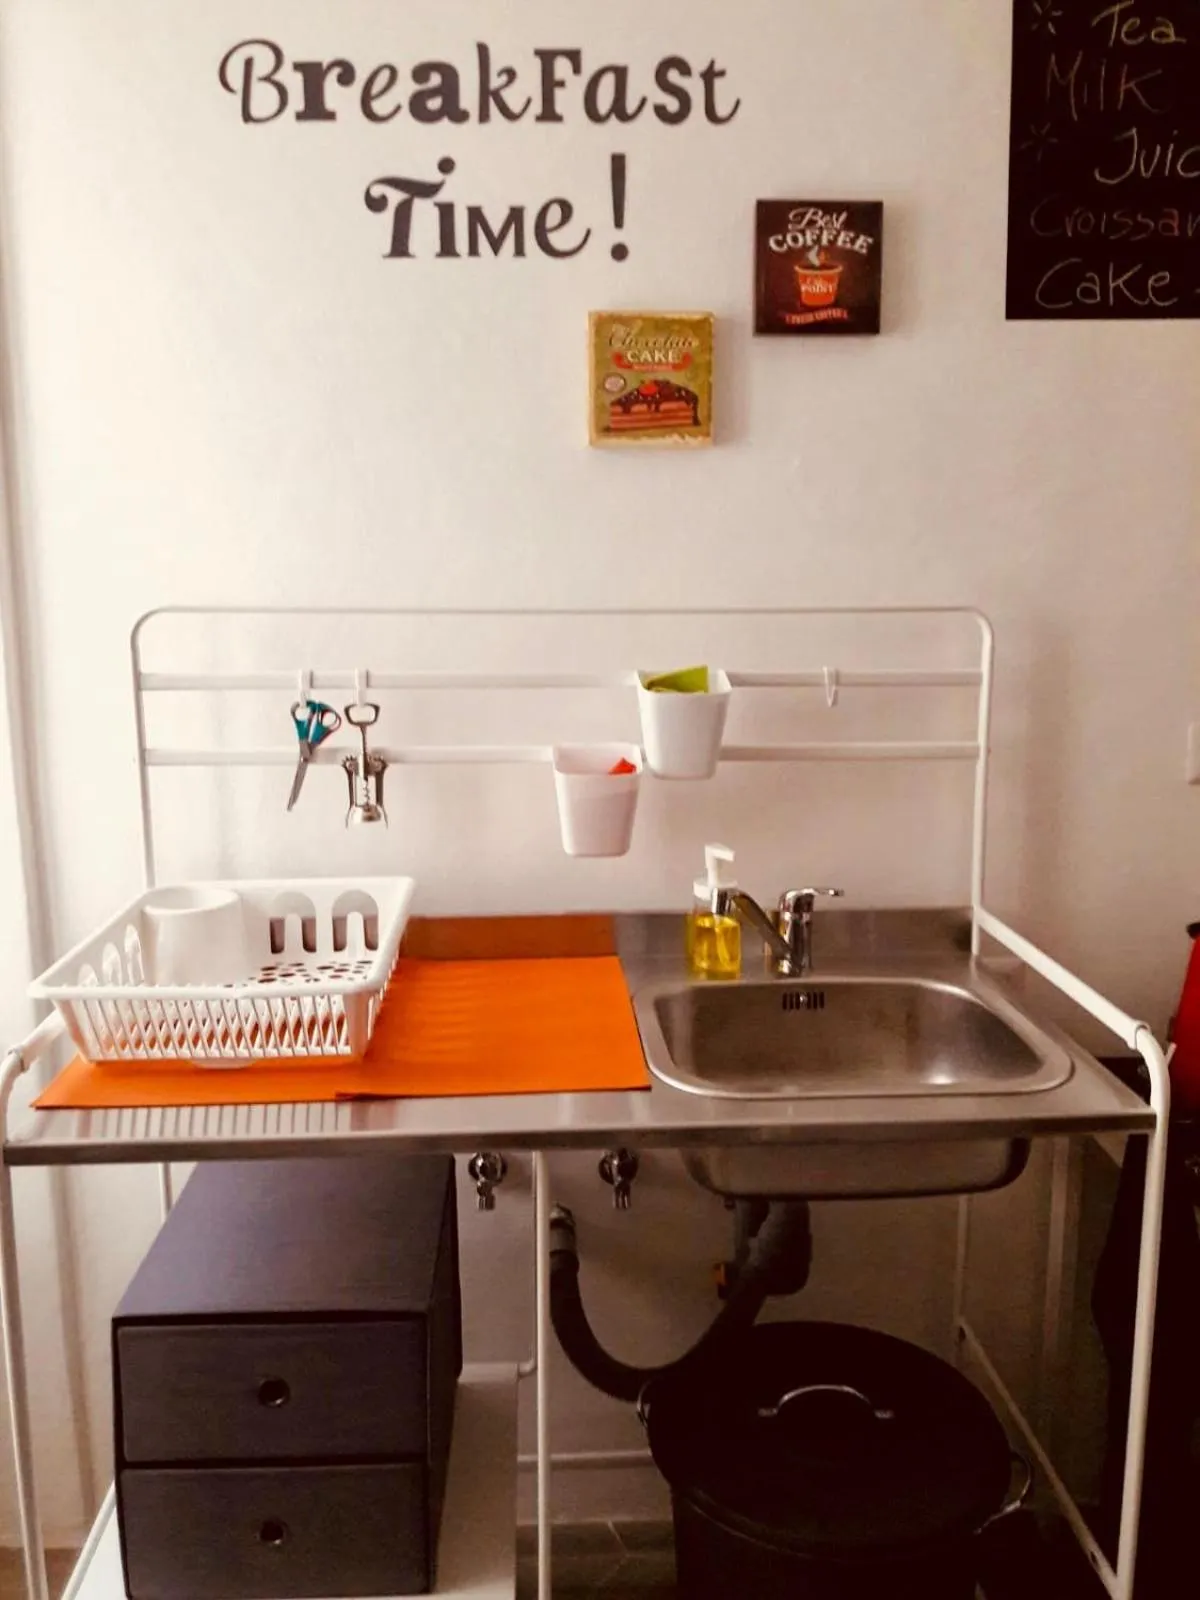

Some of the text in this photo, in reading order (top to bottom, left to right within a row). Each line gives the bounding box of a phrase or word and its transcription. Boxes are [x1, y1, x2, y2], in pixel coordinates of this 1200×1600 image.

[1092, 0, 1186, 48] Tea
[768, 229, 874, 255] COFFEE
[627, 350, 679, 363] CAKE
